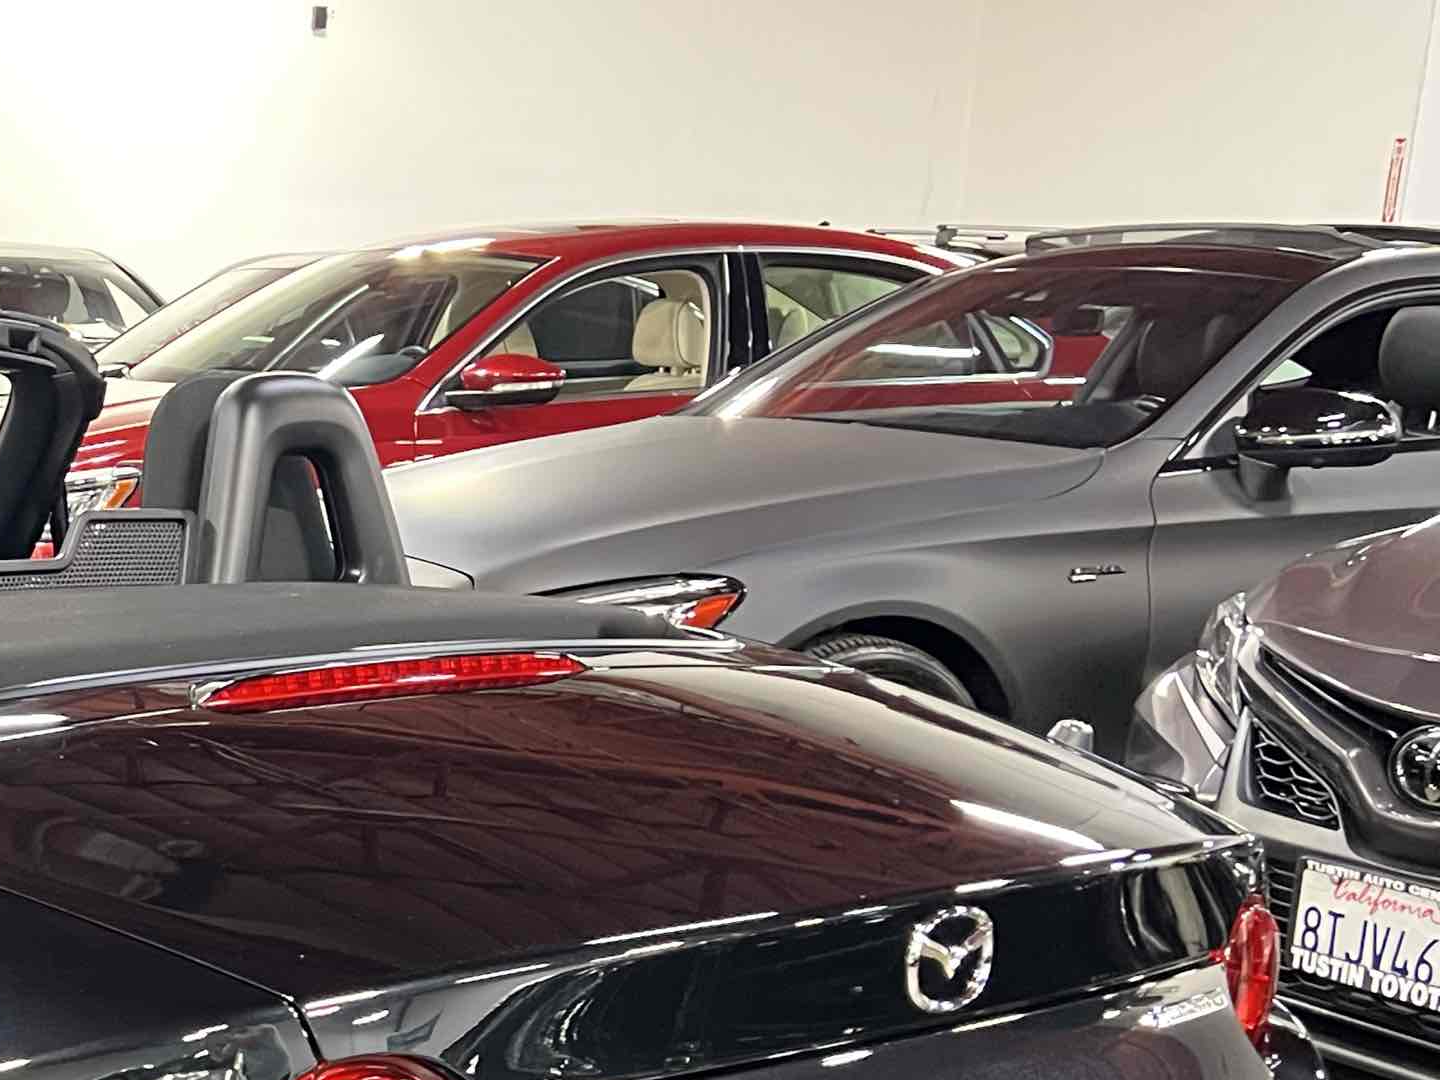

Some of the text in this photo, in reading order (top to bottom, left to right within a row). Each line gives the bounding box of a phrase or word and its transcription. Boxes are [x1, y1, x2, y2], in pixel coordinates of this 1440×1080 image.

[1363, 874, 1406, 893] AUTO
[1290, 946, 1440, 1013] TUSTIN TOYOT
